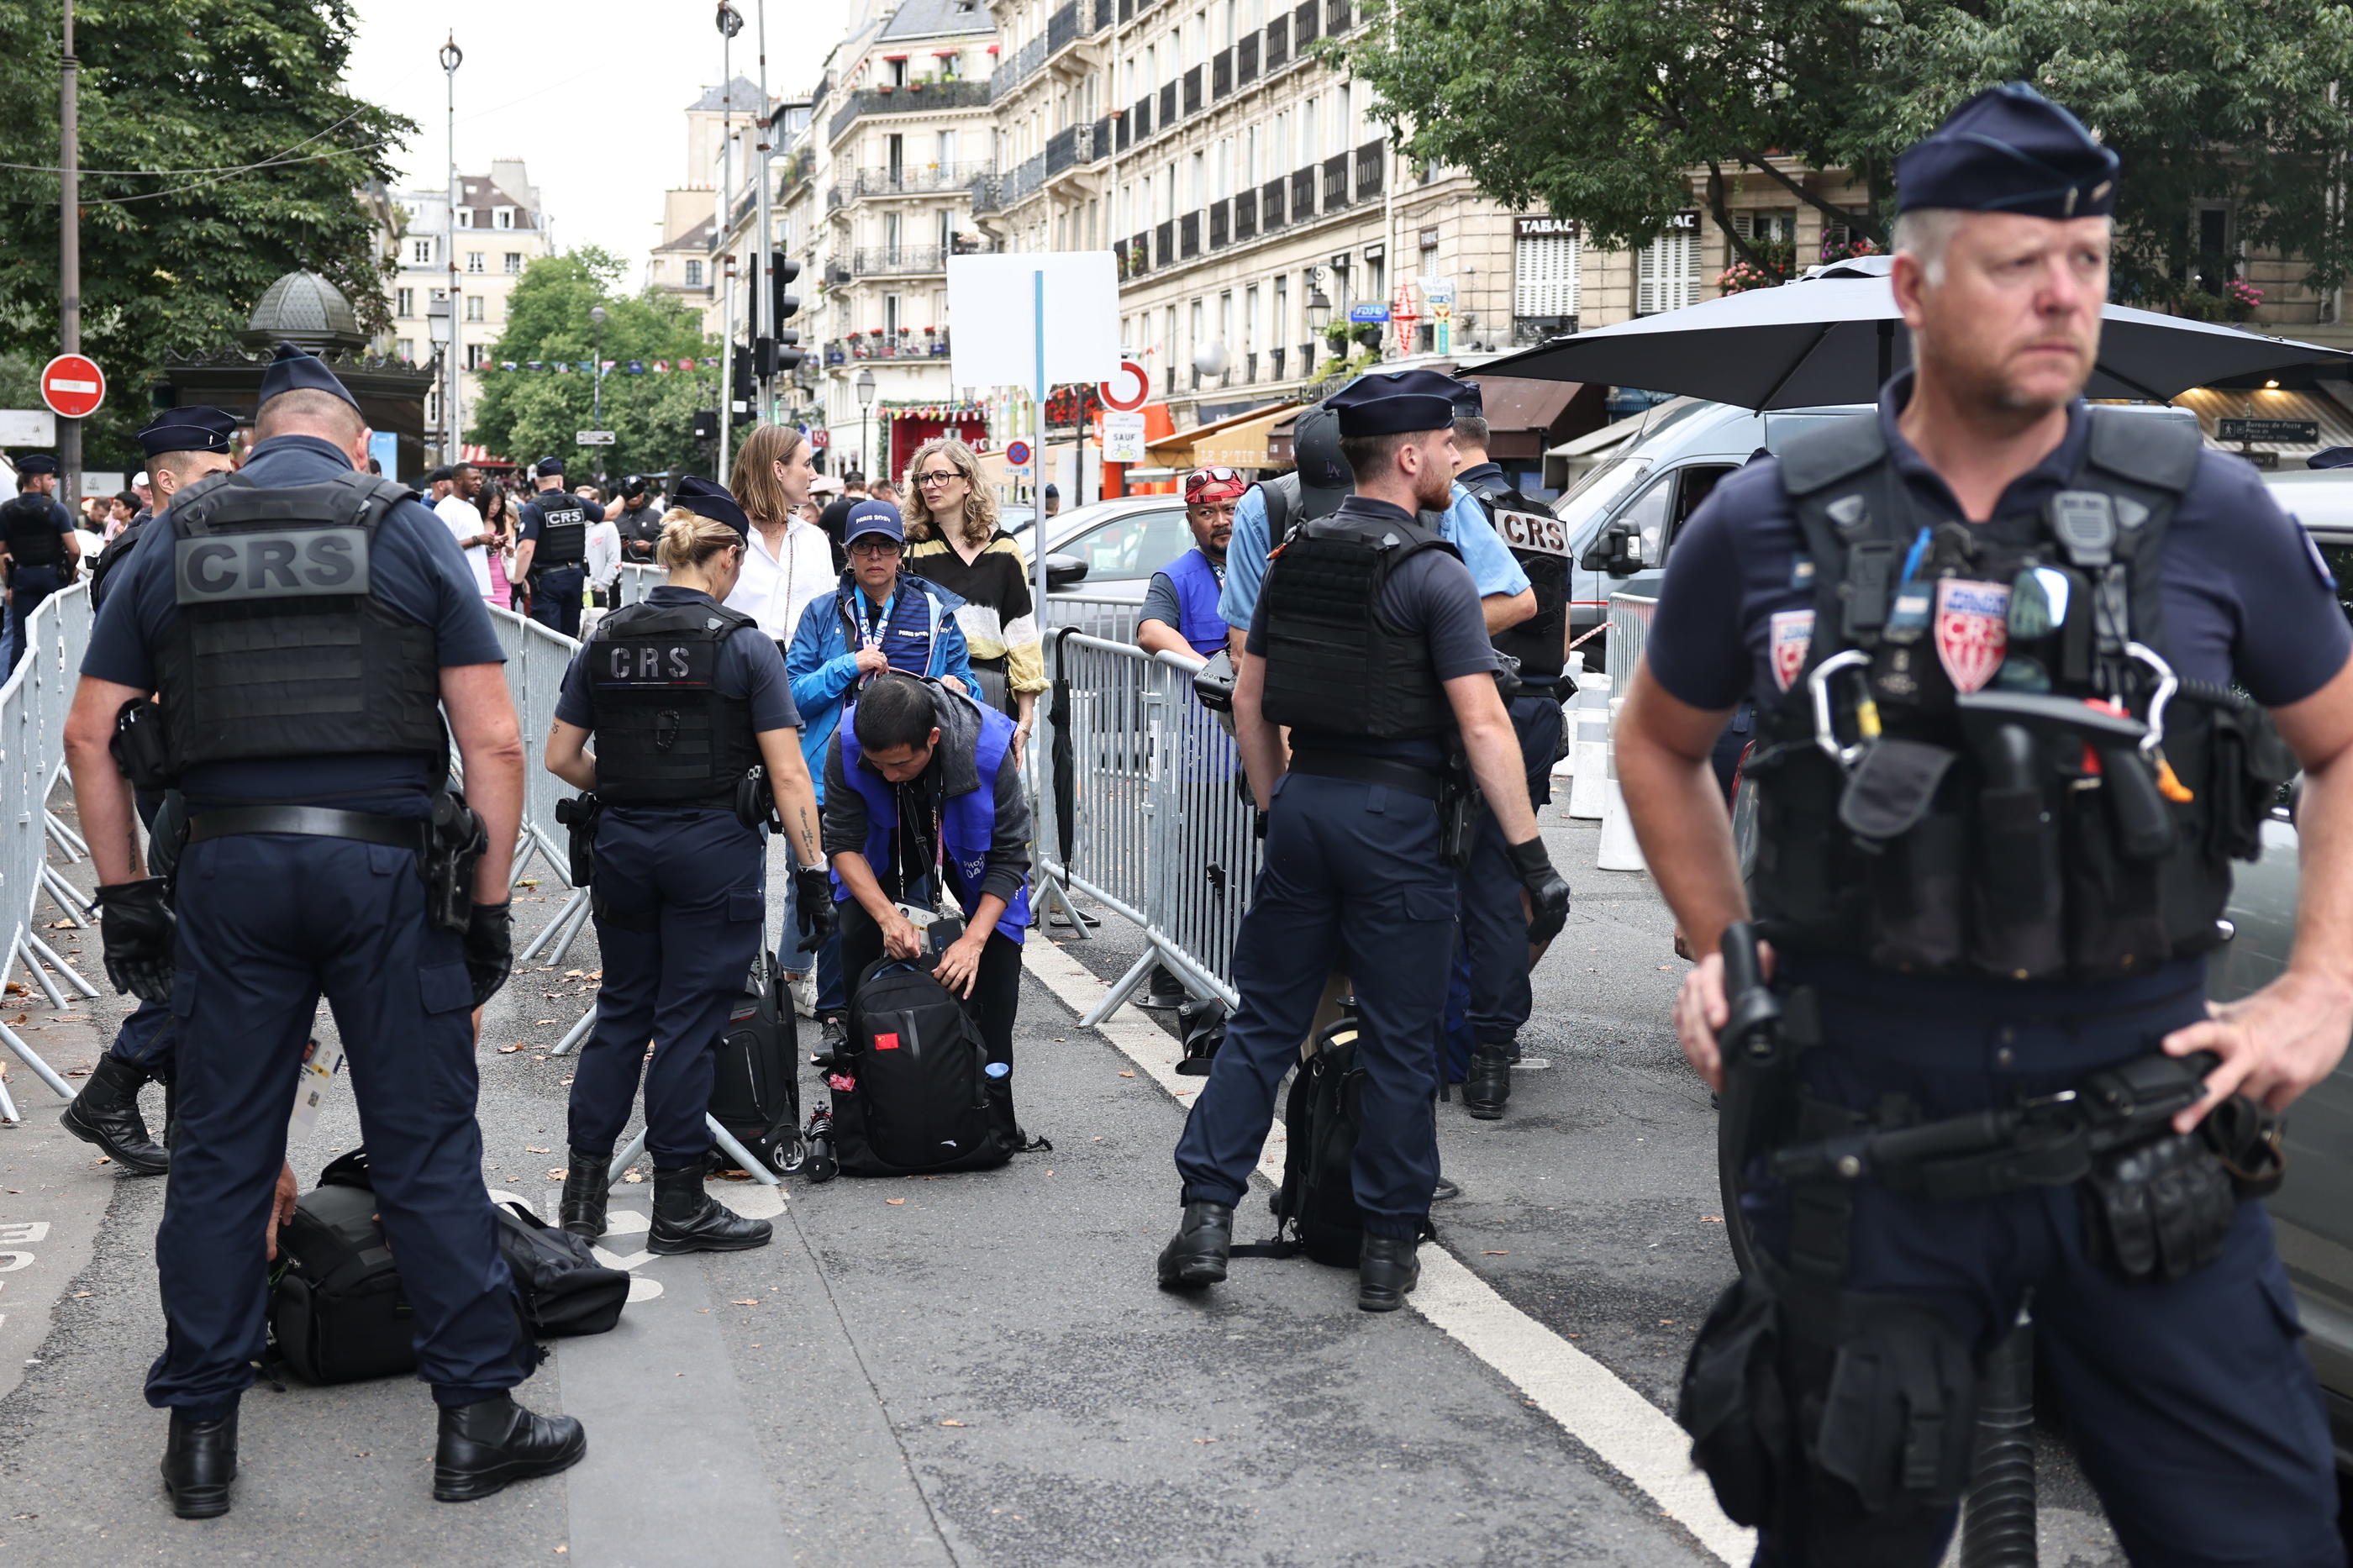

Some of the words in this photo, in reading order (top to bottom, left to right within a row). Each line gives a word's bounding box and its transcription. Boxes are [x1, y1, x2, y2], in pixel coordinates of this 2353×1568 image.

[1519, 218, 1574, 234] TABAC
[1355, 306, 1375, 316] FDJ
[1200, 450, 1215, 463] LE
[1220, 450, 1255, 463] P'TIT
[1325, 460, 1341, 478] LA
[548, 511, 582, 524] CRS
[855, 514, 873, 524] PARIS
[873, 514, 892, 523] 2024
[1503, 514, 1565, 551] CRS
[187, 535, 355, 593] CRS
[1943, 614, 2008, 646] CRS
[610, 647, 690, 678] CRS
